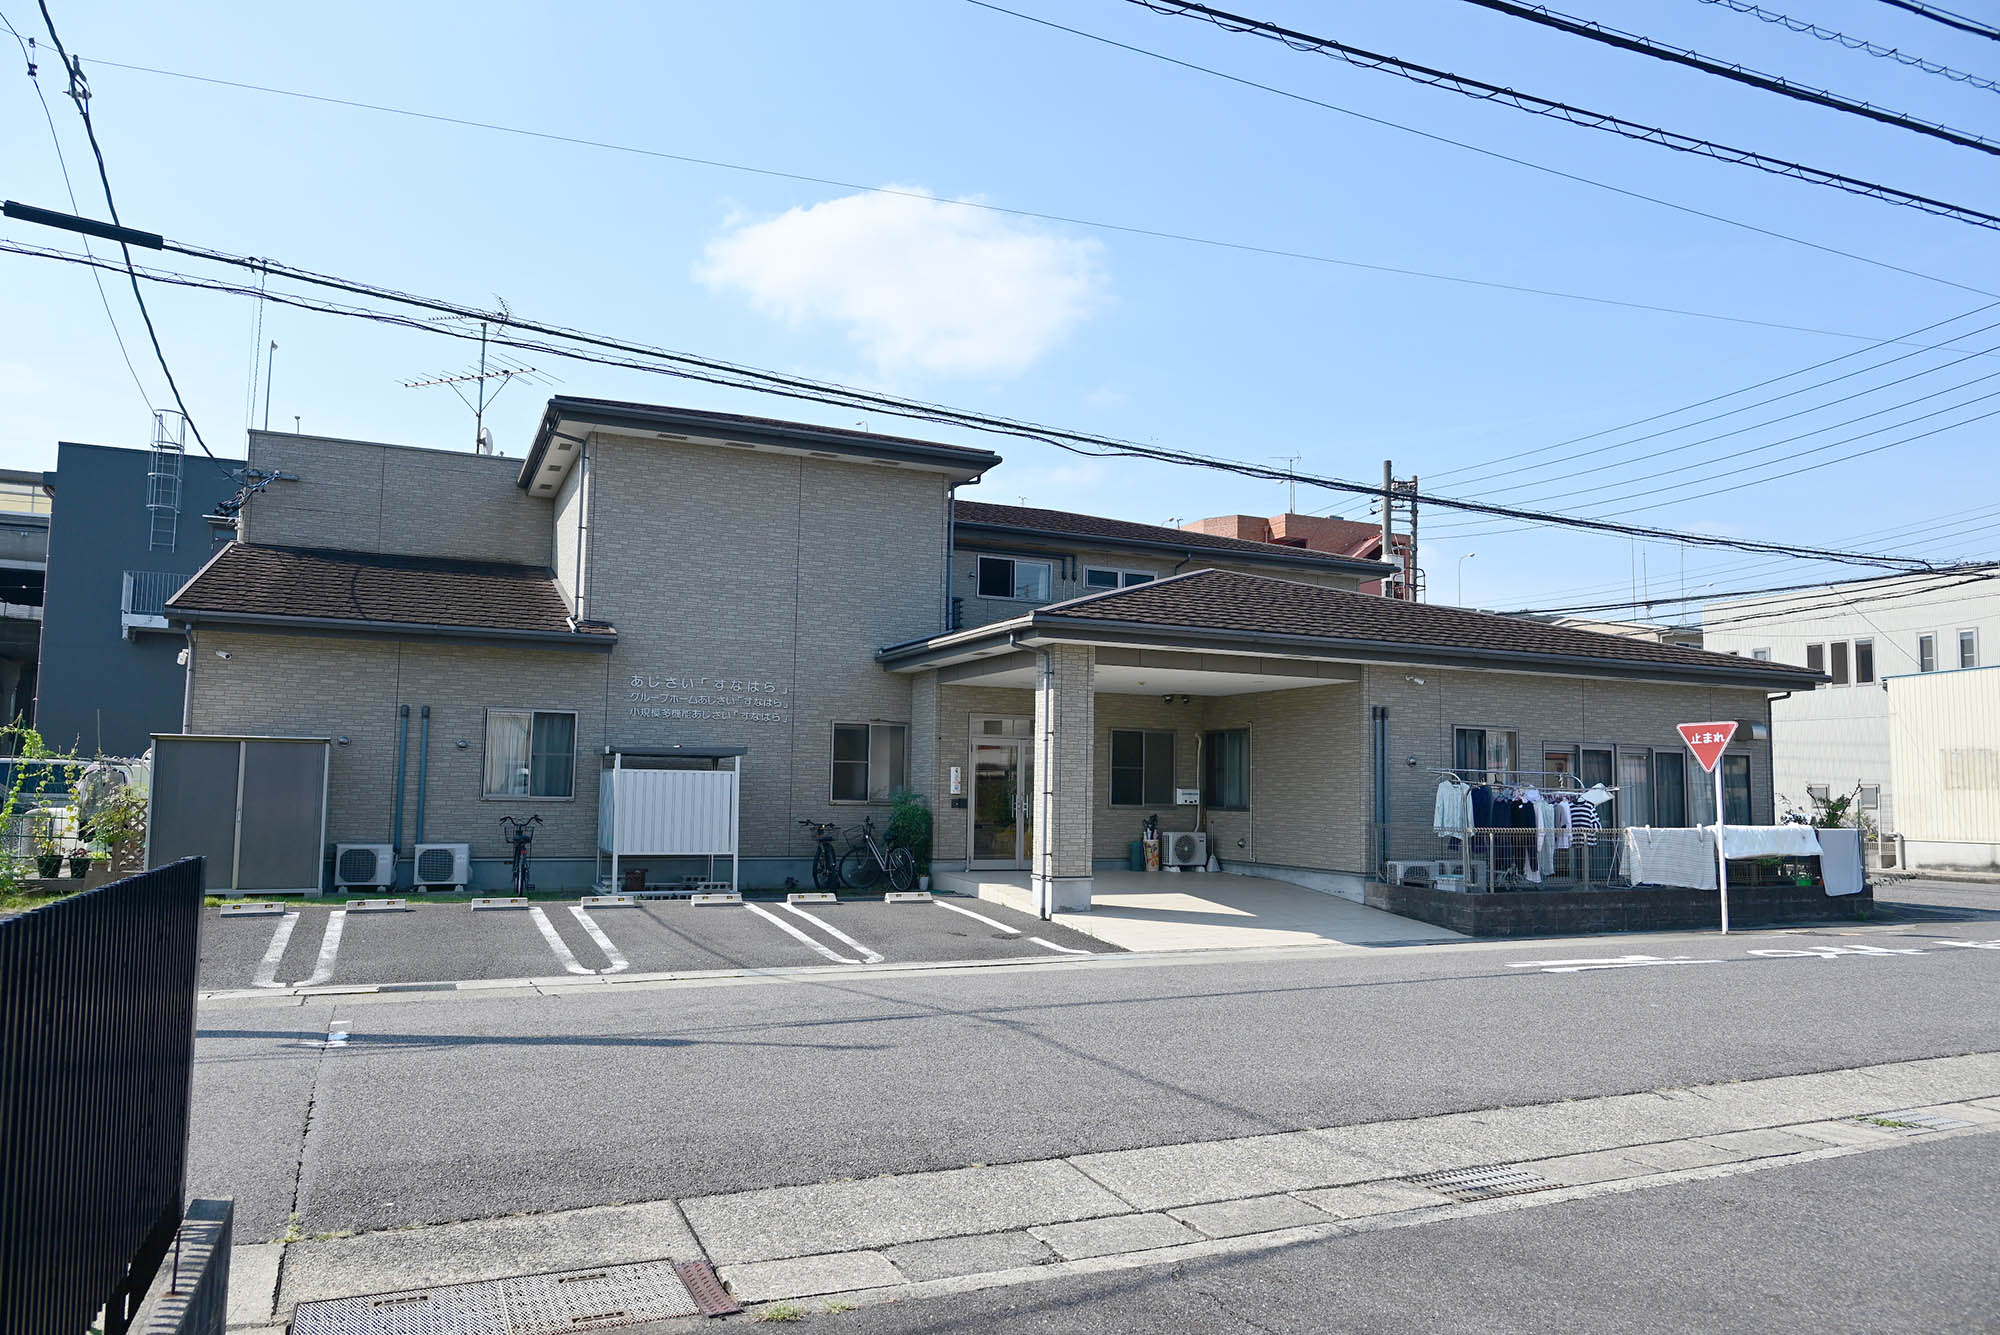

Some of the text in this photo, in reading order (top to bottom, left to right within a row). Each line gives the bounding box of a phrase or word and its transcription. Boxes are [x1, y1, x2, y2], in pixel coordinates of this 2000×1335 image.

[630, 675, 788, 694] あじさい「すなはら」
[1691, 732, 1726, 744] 止まれ
